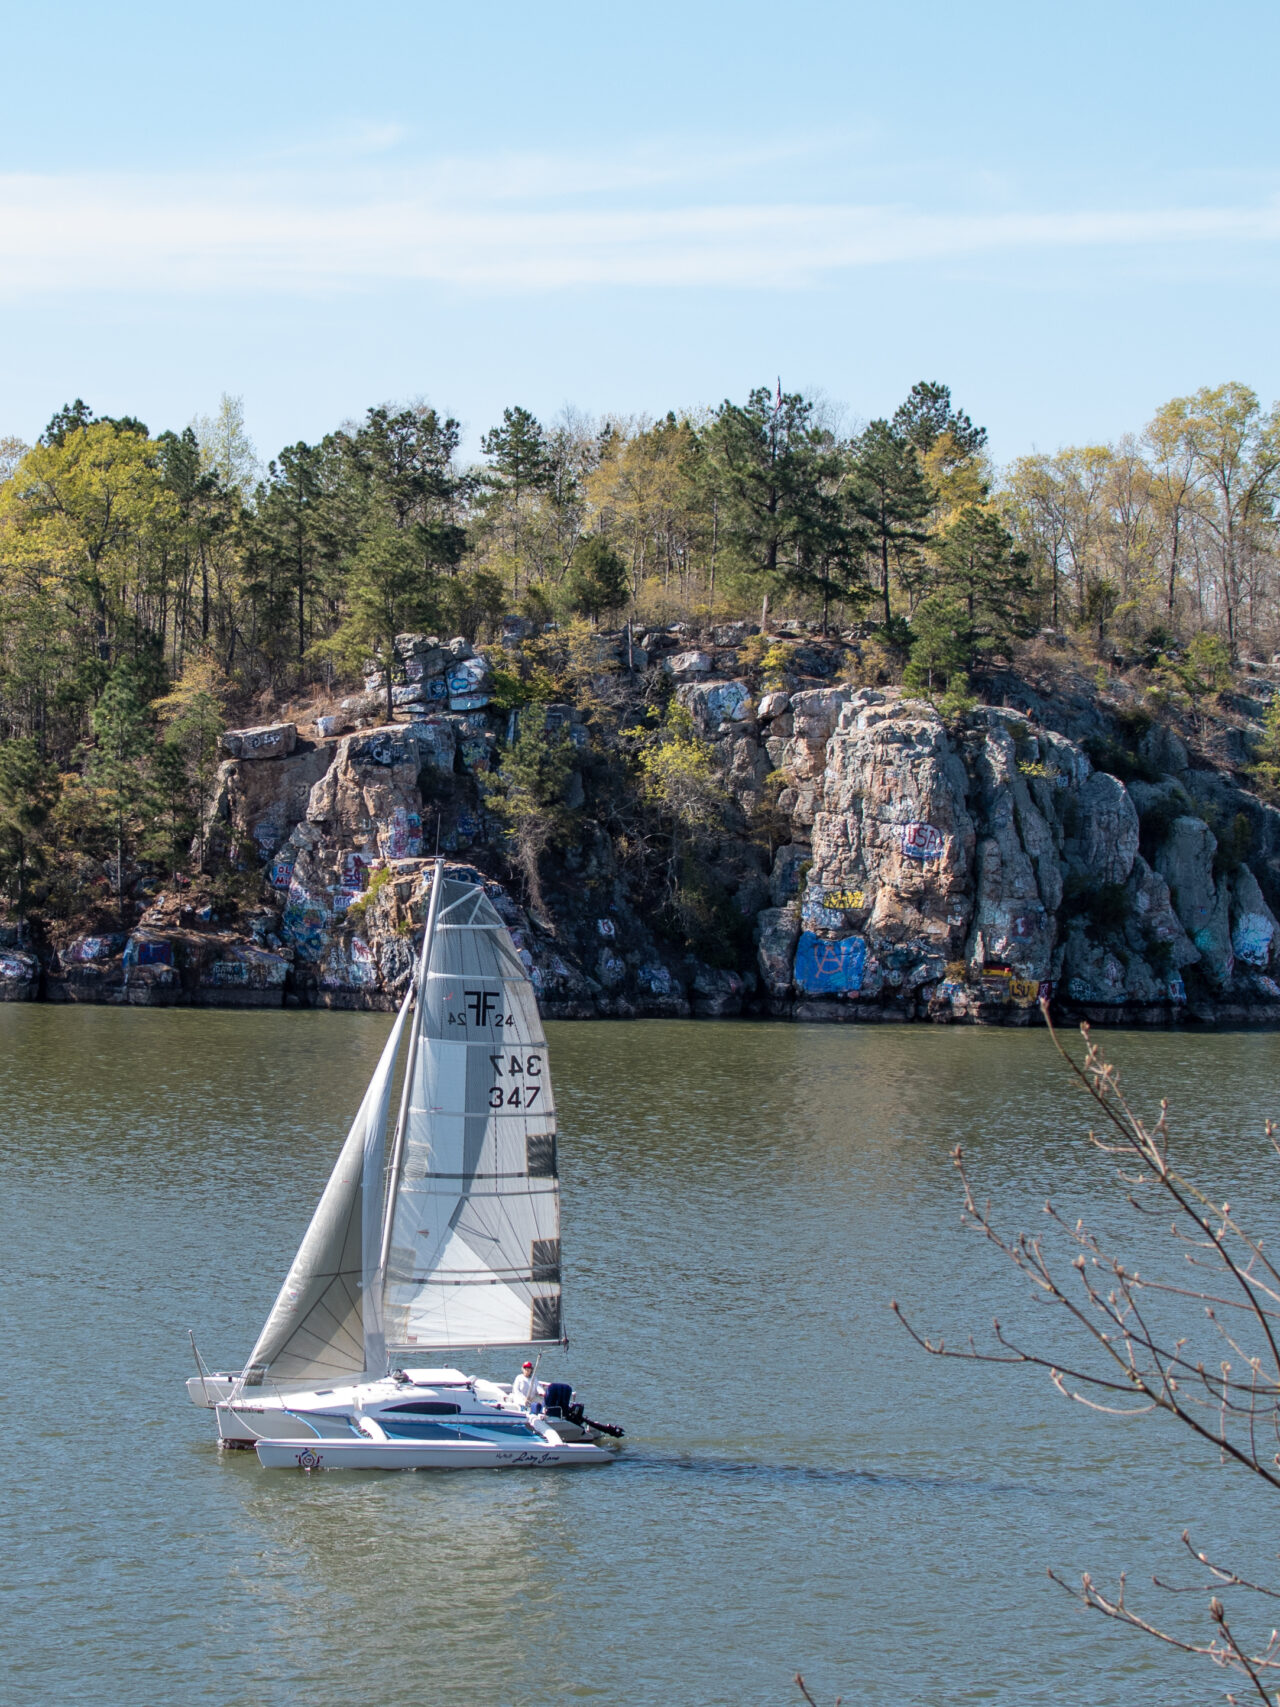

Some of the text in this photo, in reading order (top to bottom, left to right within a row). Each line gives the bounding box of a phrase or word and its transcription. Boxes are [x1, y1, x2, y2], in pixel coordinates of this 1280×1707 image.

[908, 827, 937, 850] USA
[1011, 984, 1030, 997] LSU
[495, 1014, 514, 1027] 24
[489, 1086, 541, 1108] 347
